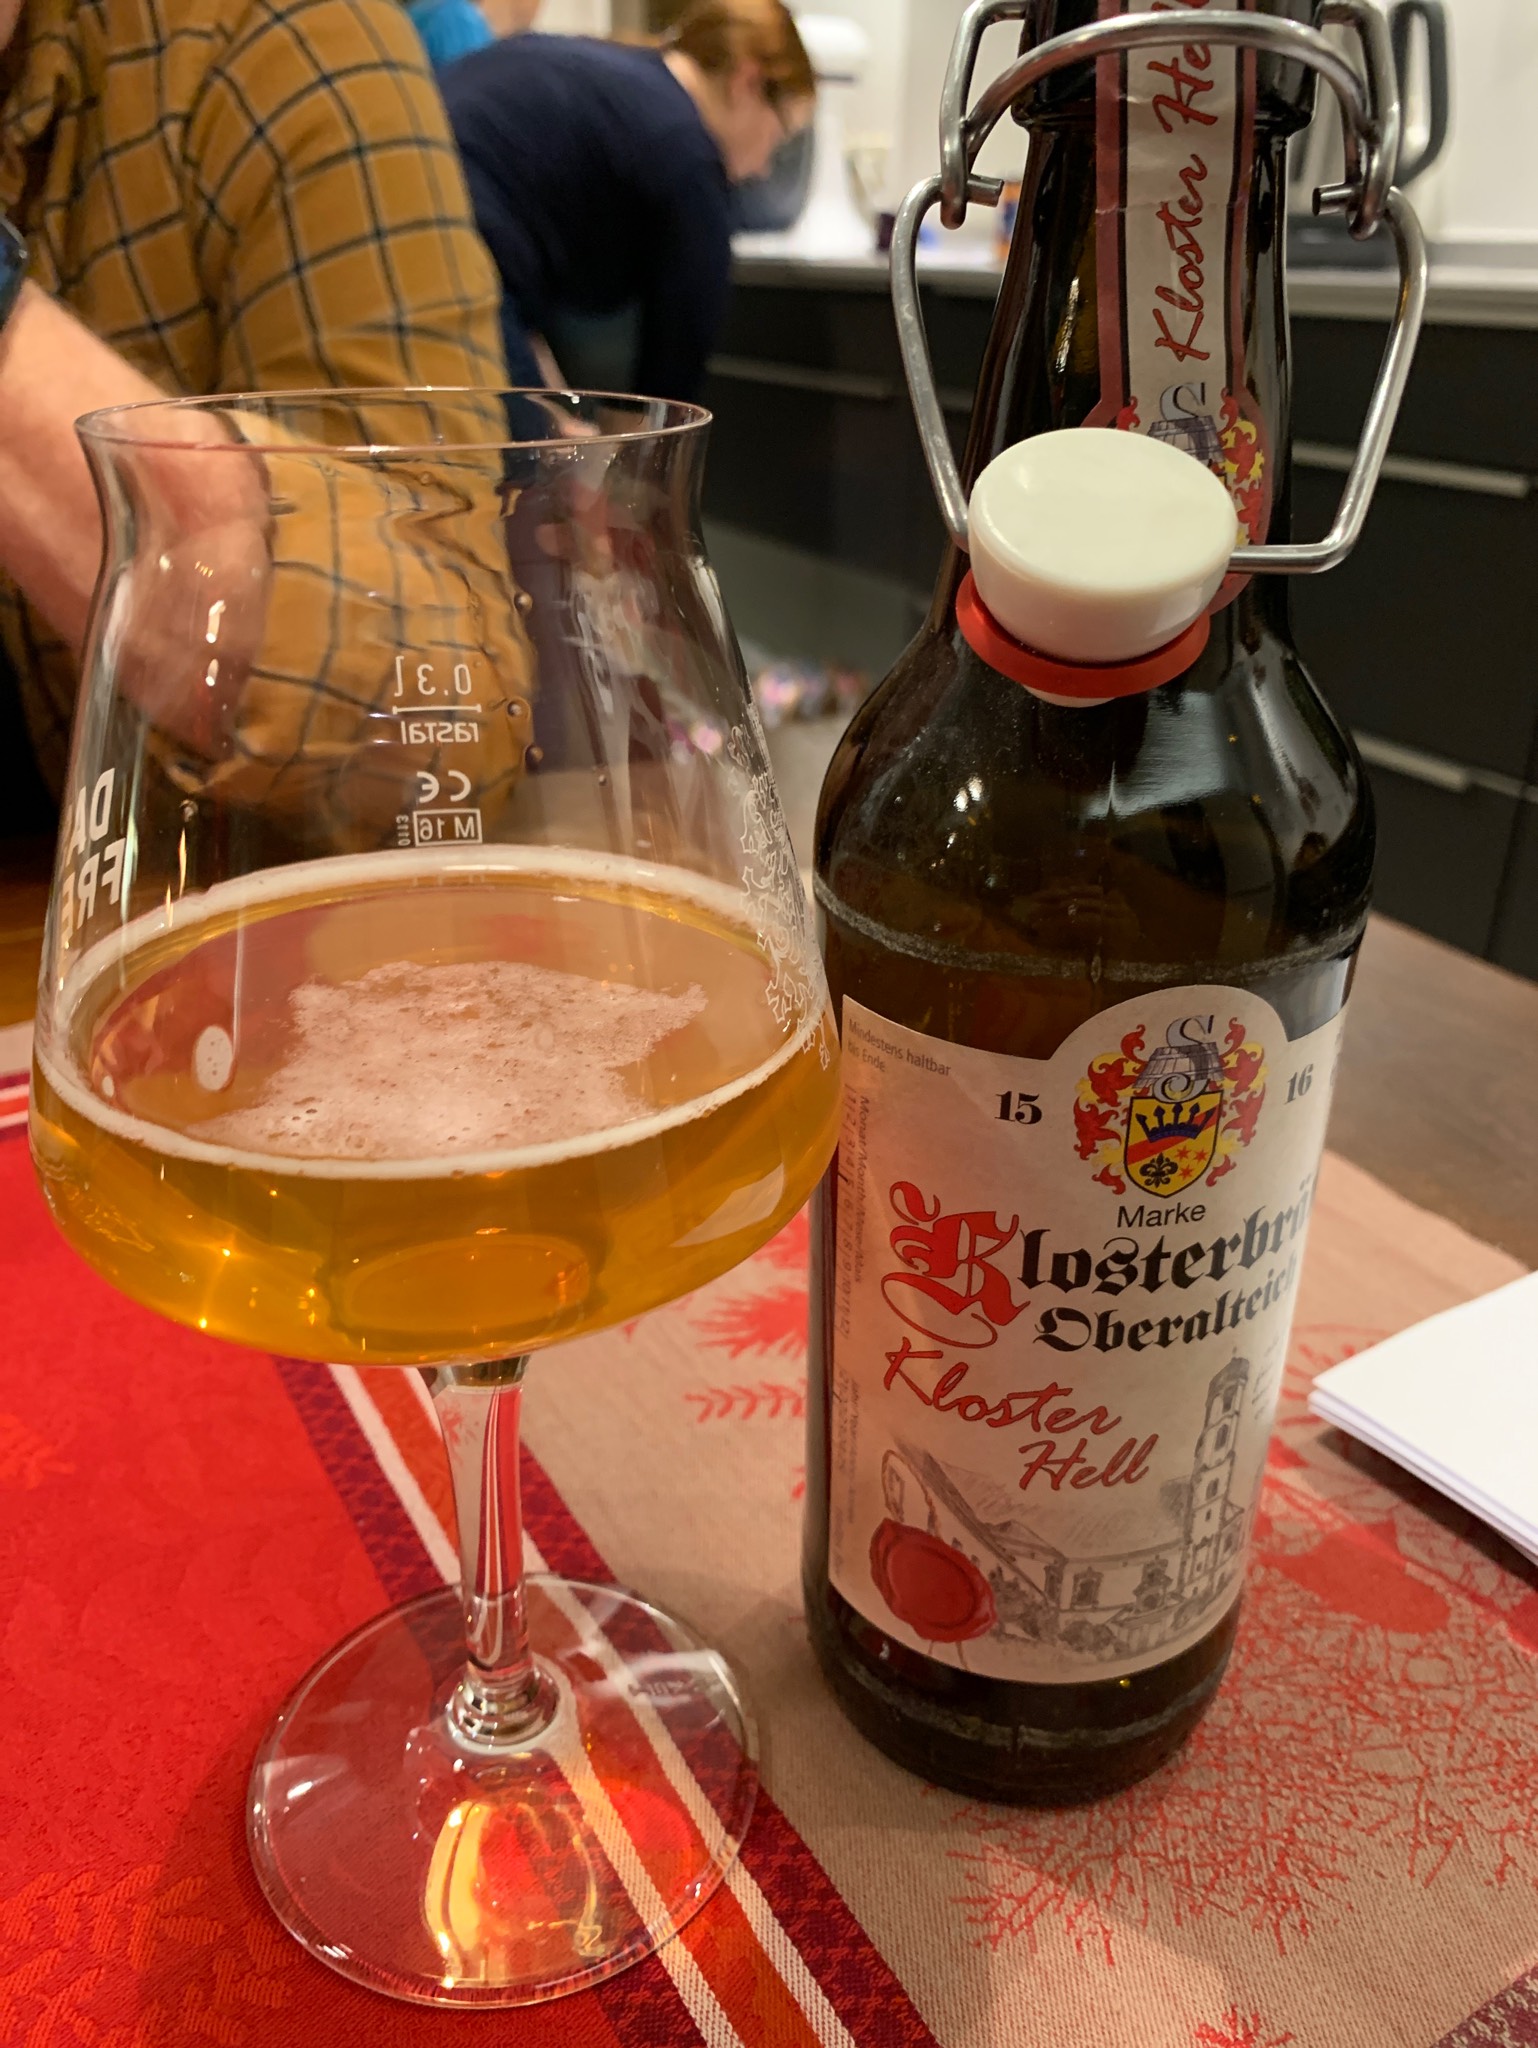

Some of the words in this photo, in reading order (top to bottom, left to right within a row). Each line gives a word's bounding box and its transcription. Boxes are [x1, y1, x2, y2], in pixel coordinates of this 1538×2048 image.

[1146, 0, 1219, 134] He
[1152, 153, 1210, 362] Kloster
[848, 1017, 904, 1060] Mindestens
[906, 1047, 952, 1077] haltbar
[862, 1048, 887, 1073] Ende
[994, 1091, 1043, 1126] 15
[1283, 1063, 1314, 1105] 16
[1116, 1202, 1207, 1229] Marke
[883, 1336, 1122, 1436] Kloster
[1017, 1433, 1160, 1491] Hell
